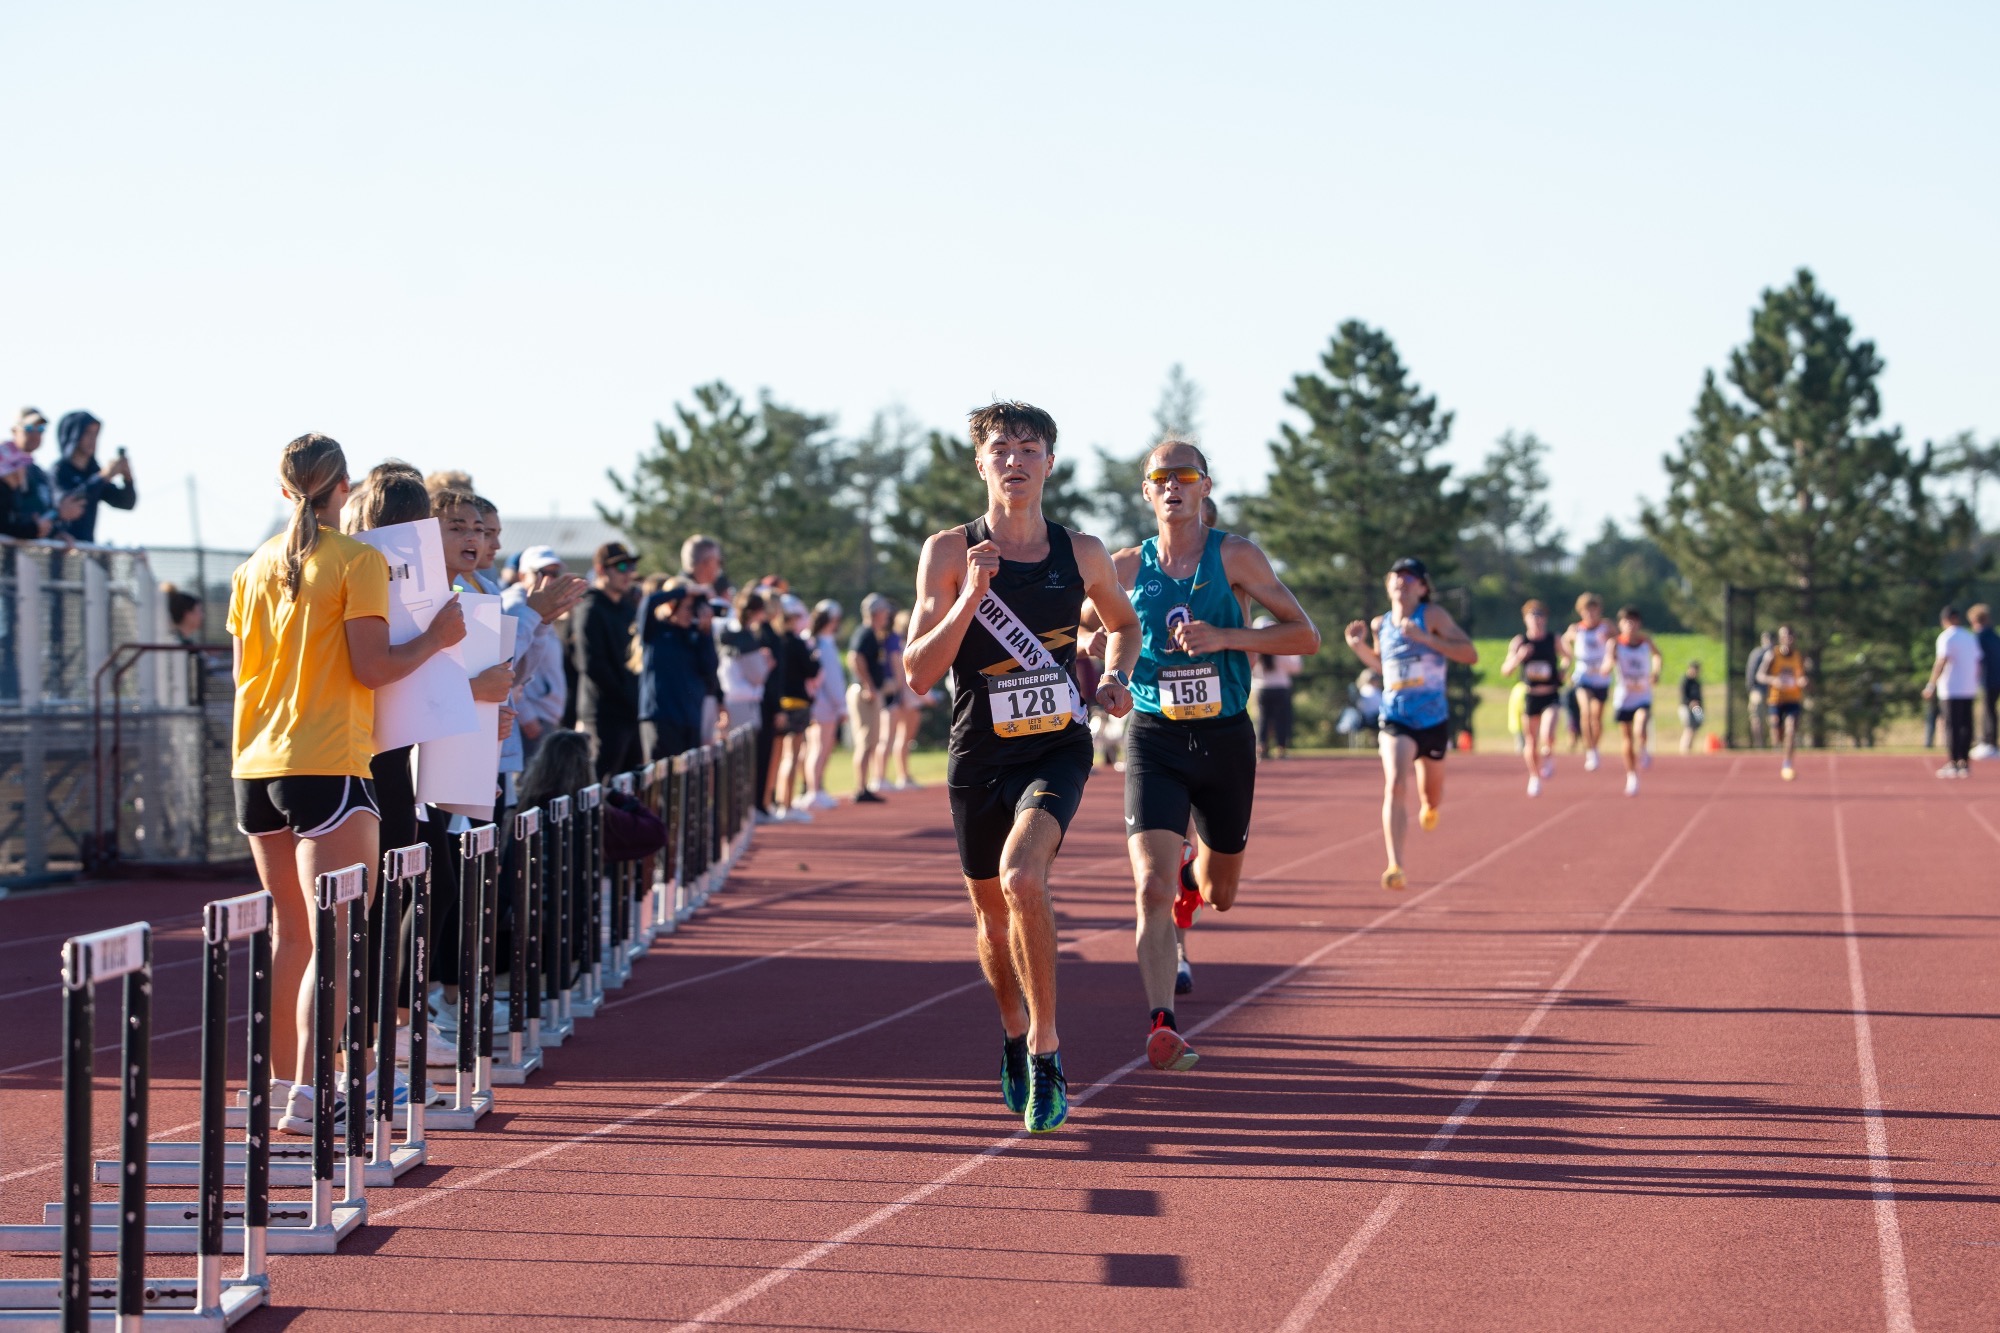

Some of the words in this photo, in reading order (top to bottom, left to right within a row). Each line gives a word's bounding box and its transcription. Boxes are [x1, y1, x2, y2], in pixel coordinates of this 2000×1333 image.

[1147, 584, 1159, 592] N7
[1005, 626, 1043, 667] HAYS
[997, 679, 1017, 689] FHSU
[1018, 676, 1039, 685] TIGER
[1039, 672, 1059, 682] OPEN
[1162, 670, 1177, 678] FHSU
[1177, 669, 1196, 677] TIGER
[1195, 667, 1212, 676] OPEN
[1169, 679, 1208, 705] 158
[1008, 687, 1057, 719] 128
